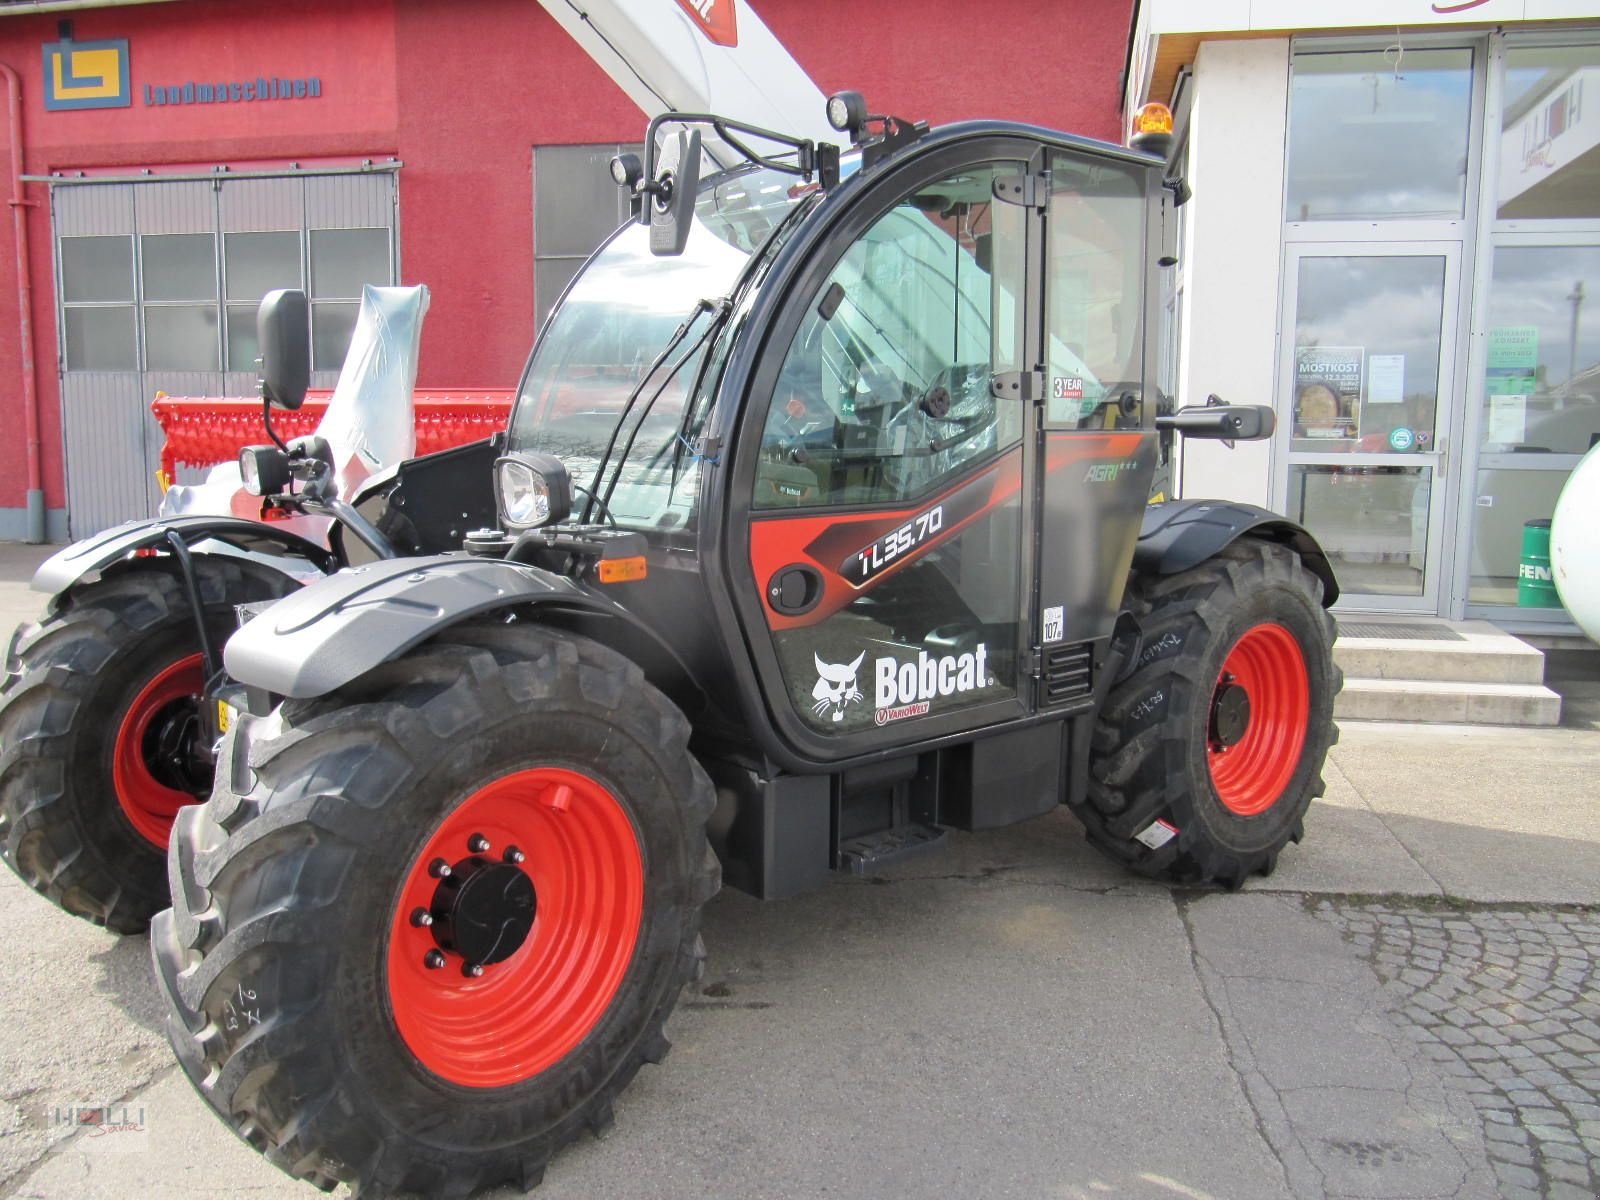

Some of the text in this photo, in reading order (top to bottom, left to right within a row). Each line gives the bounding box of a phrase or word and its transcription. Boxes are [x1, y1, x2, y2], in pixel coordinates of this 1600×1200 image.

[144, 77, 322, 106] Landmaschinen
[1299, 363, 1359, 373] MOSTKOST
[1054, 378, 1082, 398] 3 YEAR
[1083, 464, 1119, 482] AGRI
[858, 505, 943, 576] TL35.70
[1520, 564, 1552, 581] FEN
[1045, 621, 1058, 640] 107
[875, 643, 987, 708] Bobcat
